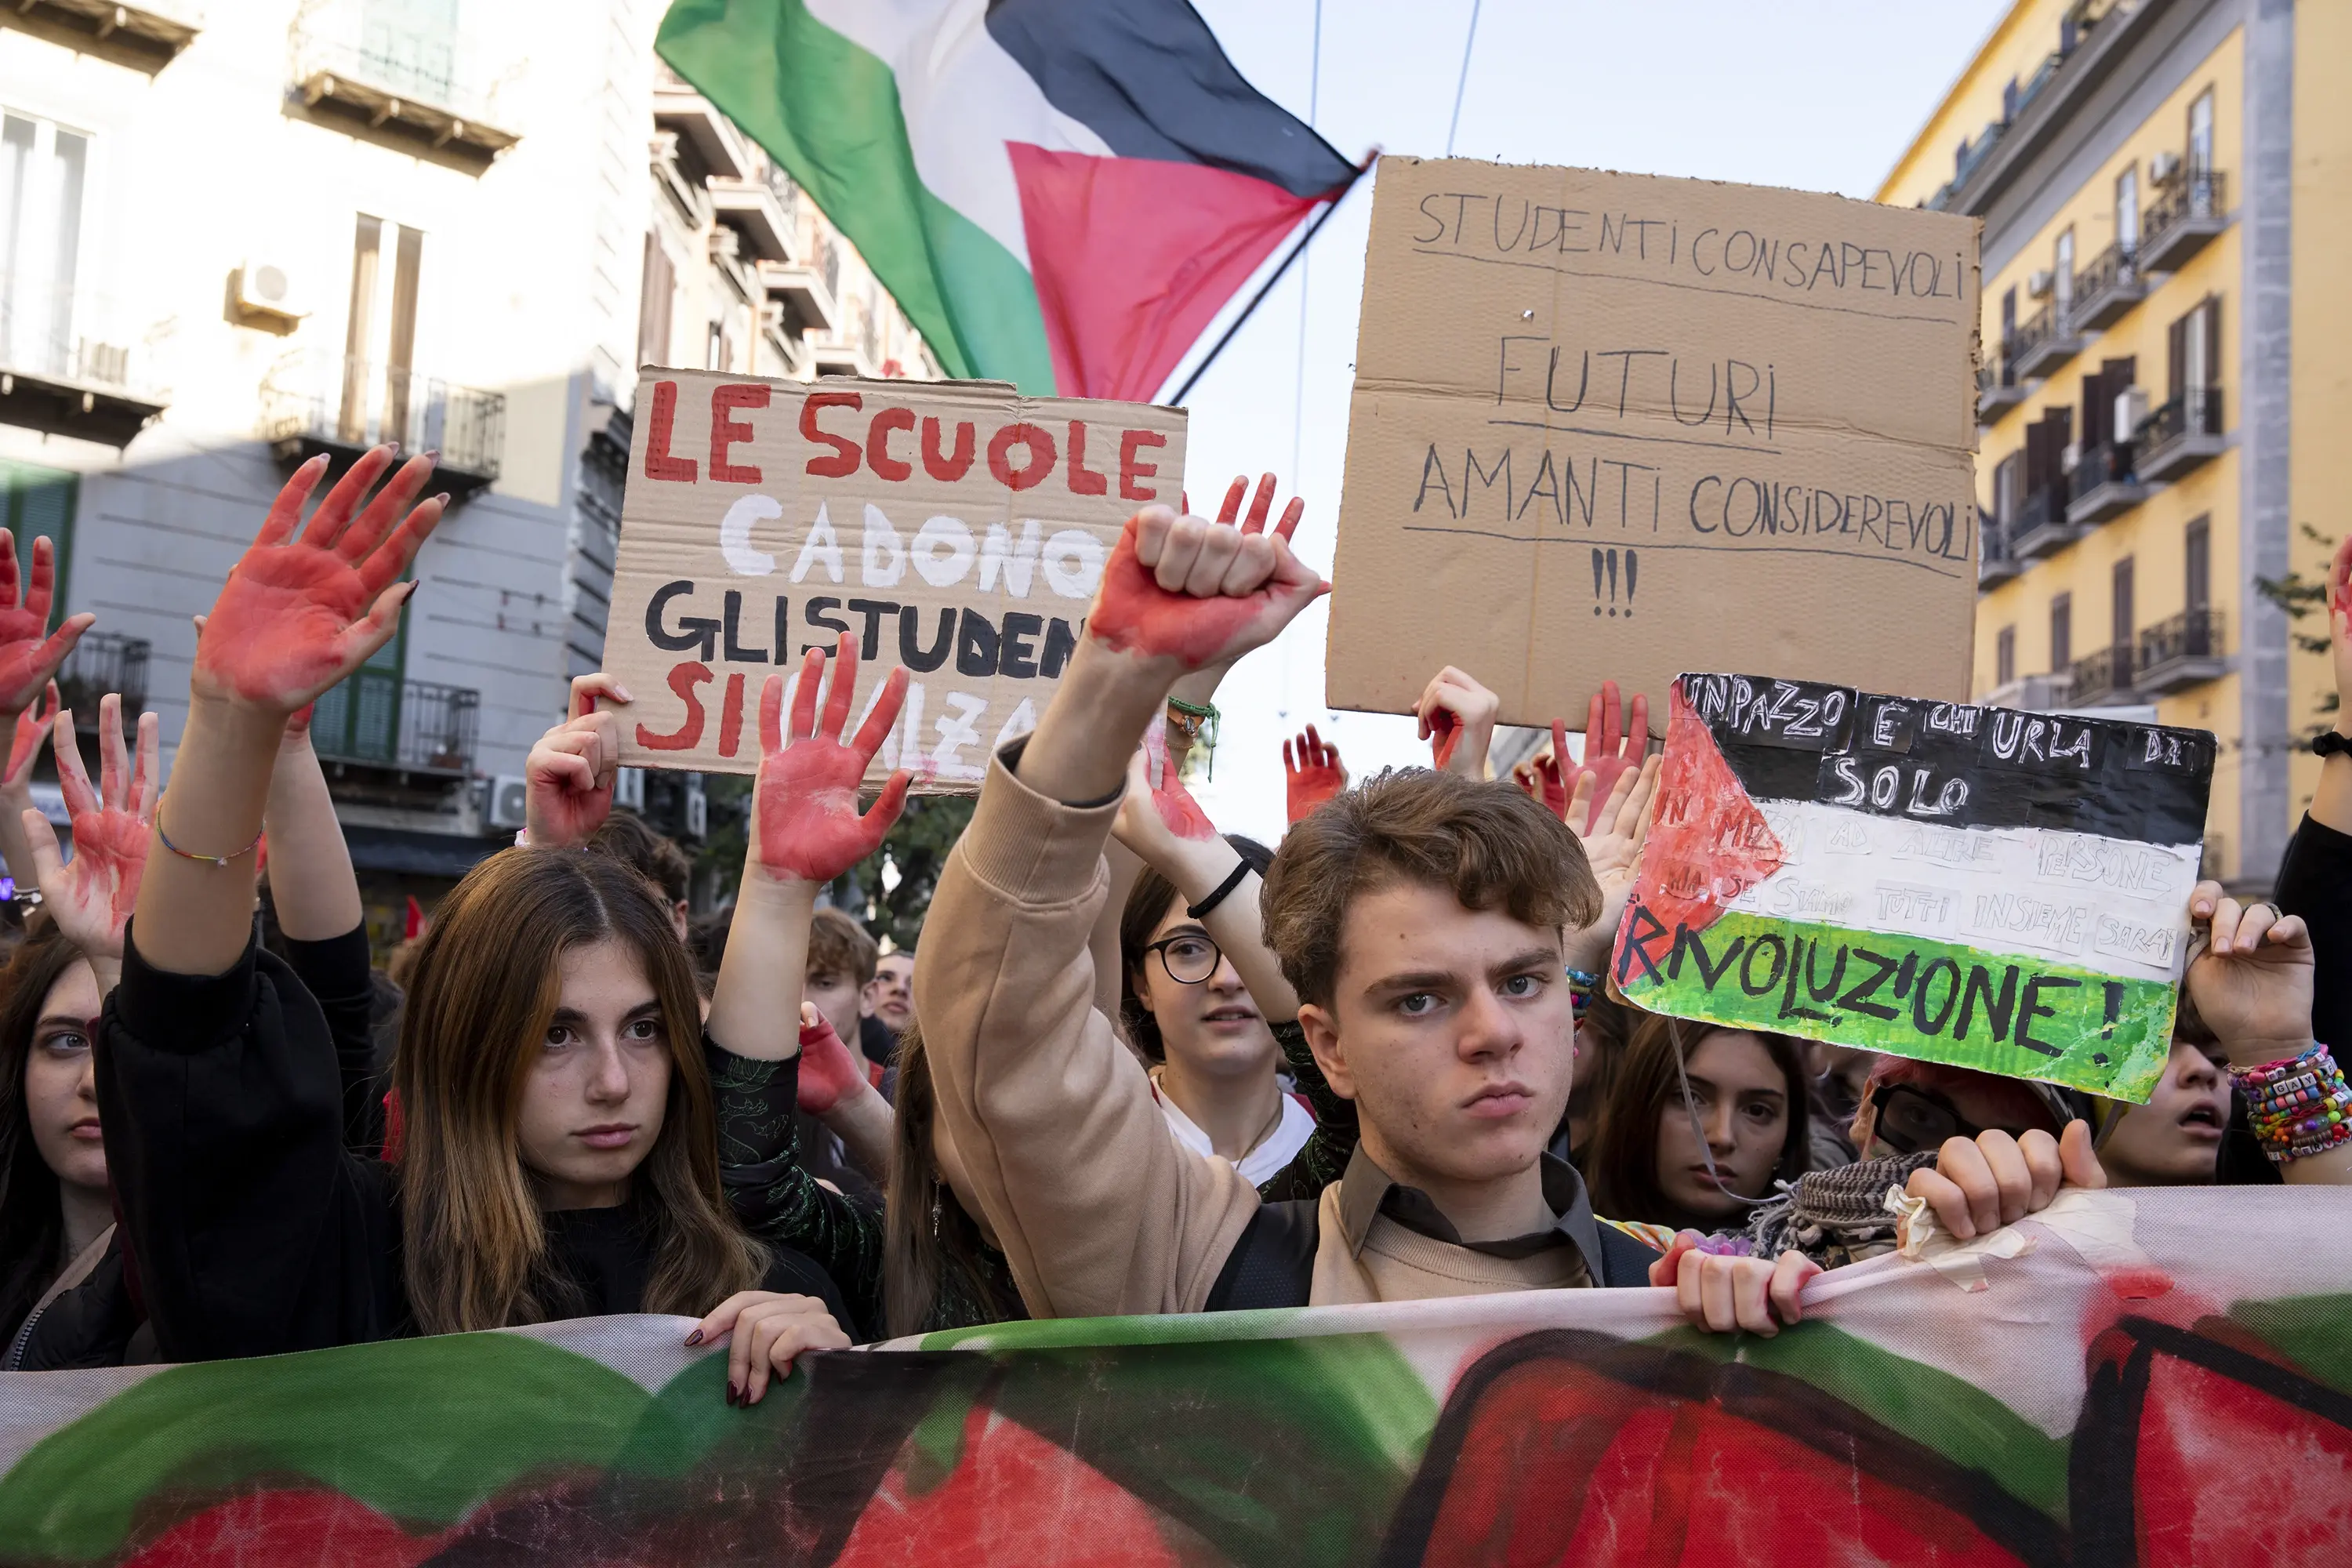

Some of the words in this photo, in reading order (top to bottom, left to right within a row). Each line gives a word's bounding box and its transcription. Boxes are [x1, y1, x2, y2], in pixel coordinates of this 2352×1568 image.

[644, 381, 771, 485] LE
[799, 393, 1167, 502] SCUOLE
[720, 494, 1104, 599] CADONO
[1591, 548, 1639, 619] !!!
[645, 580, 788, 665] GLI
[801, 596, 1086, 679] STUDEN
[636, 661, 744, 757] SI
[1991, 712, 2091, 769] URLA
[1834, 756, 1969, 815] SOLO
[1830, 820, 1867, 848] AD
[1898, 829, 1994, 862] ALTRE
[2038, 835, 2171, 892] PERSONE
[1875, 887, 1951, 924] TUTTI
[1972, 893, 2087, 944] INSIEME
[2276, 1075, 2314, 1094] GAY
